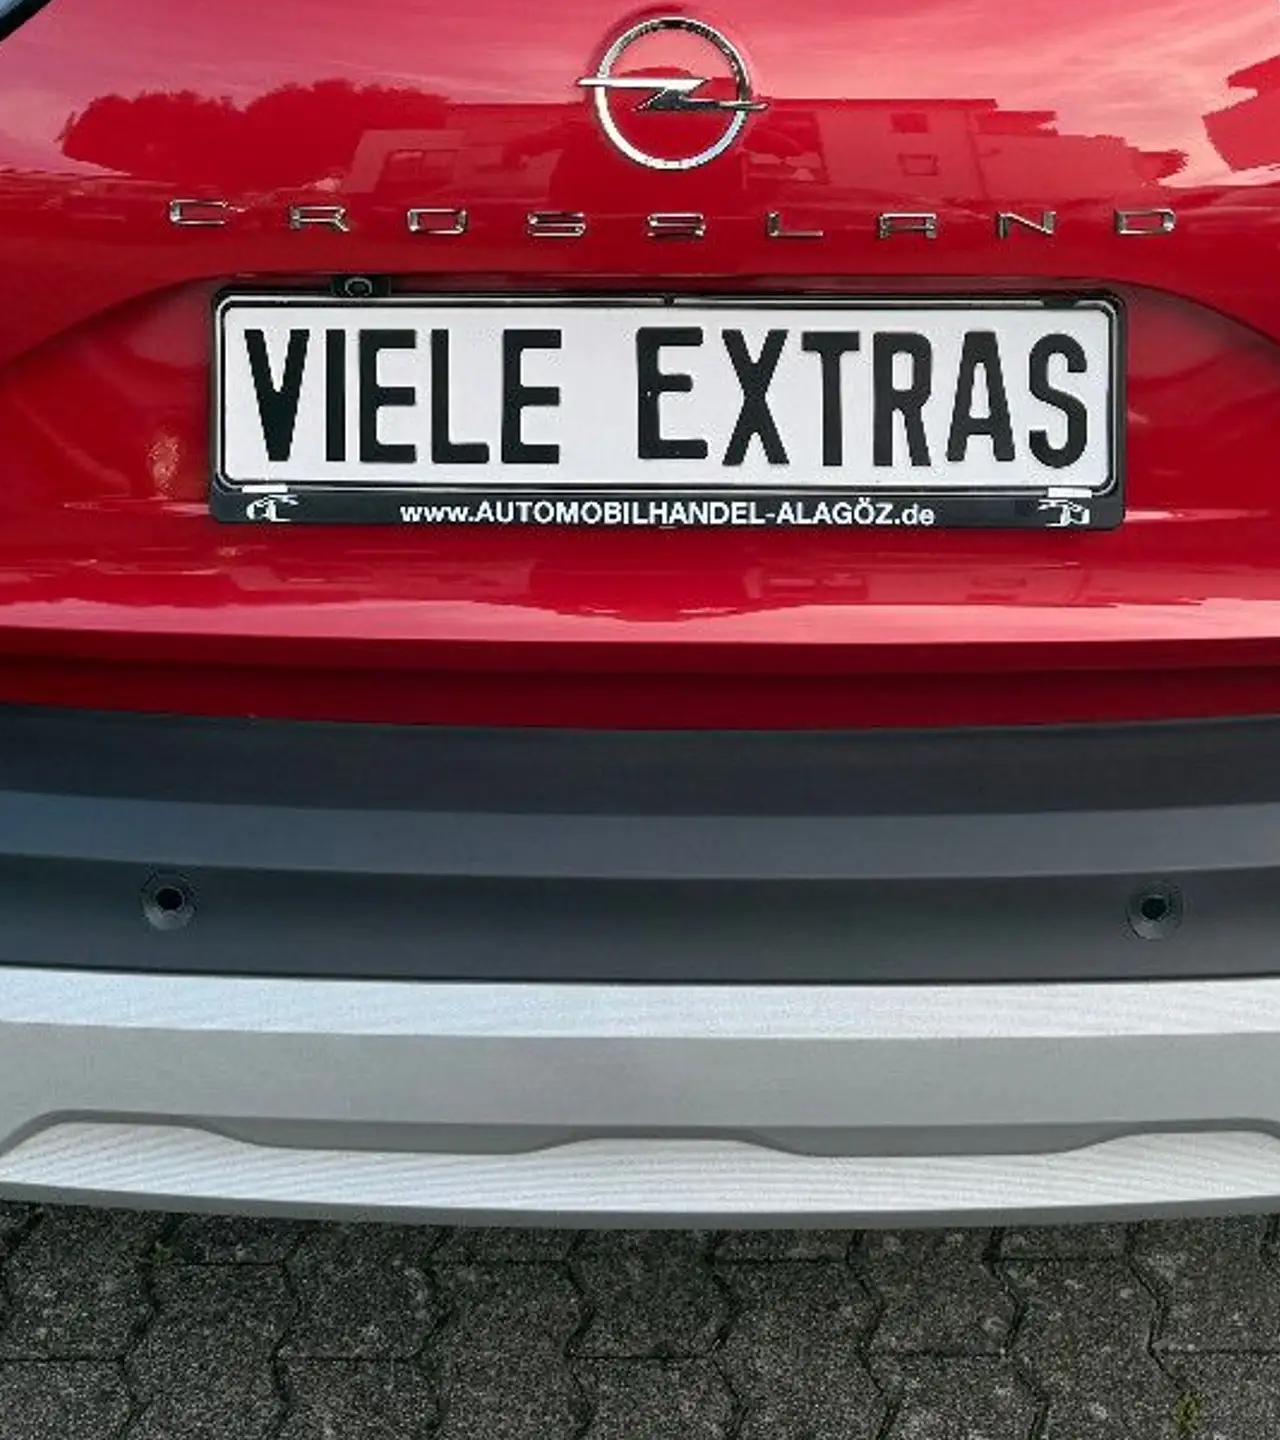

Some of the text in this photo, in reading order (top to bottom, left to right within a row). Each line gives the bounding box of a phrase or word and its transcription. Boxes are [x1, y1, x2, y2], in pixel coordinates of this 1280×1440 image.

[169, 197, 1178, 240] CROSSLAND
[243, 326, 1088, 468] VIELE EXTRAS
[399, 496, 936, 527] www.AUTOMOBILHANDEL-ALAGÖZ.de
